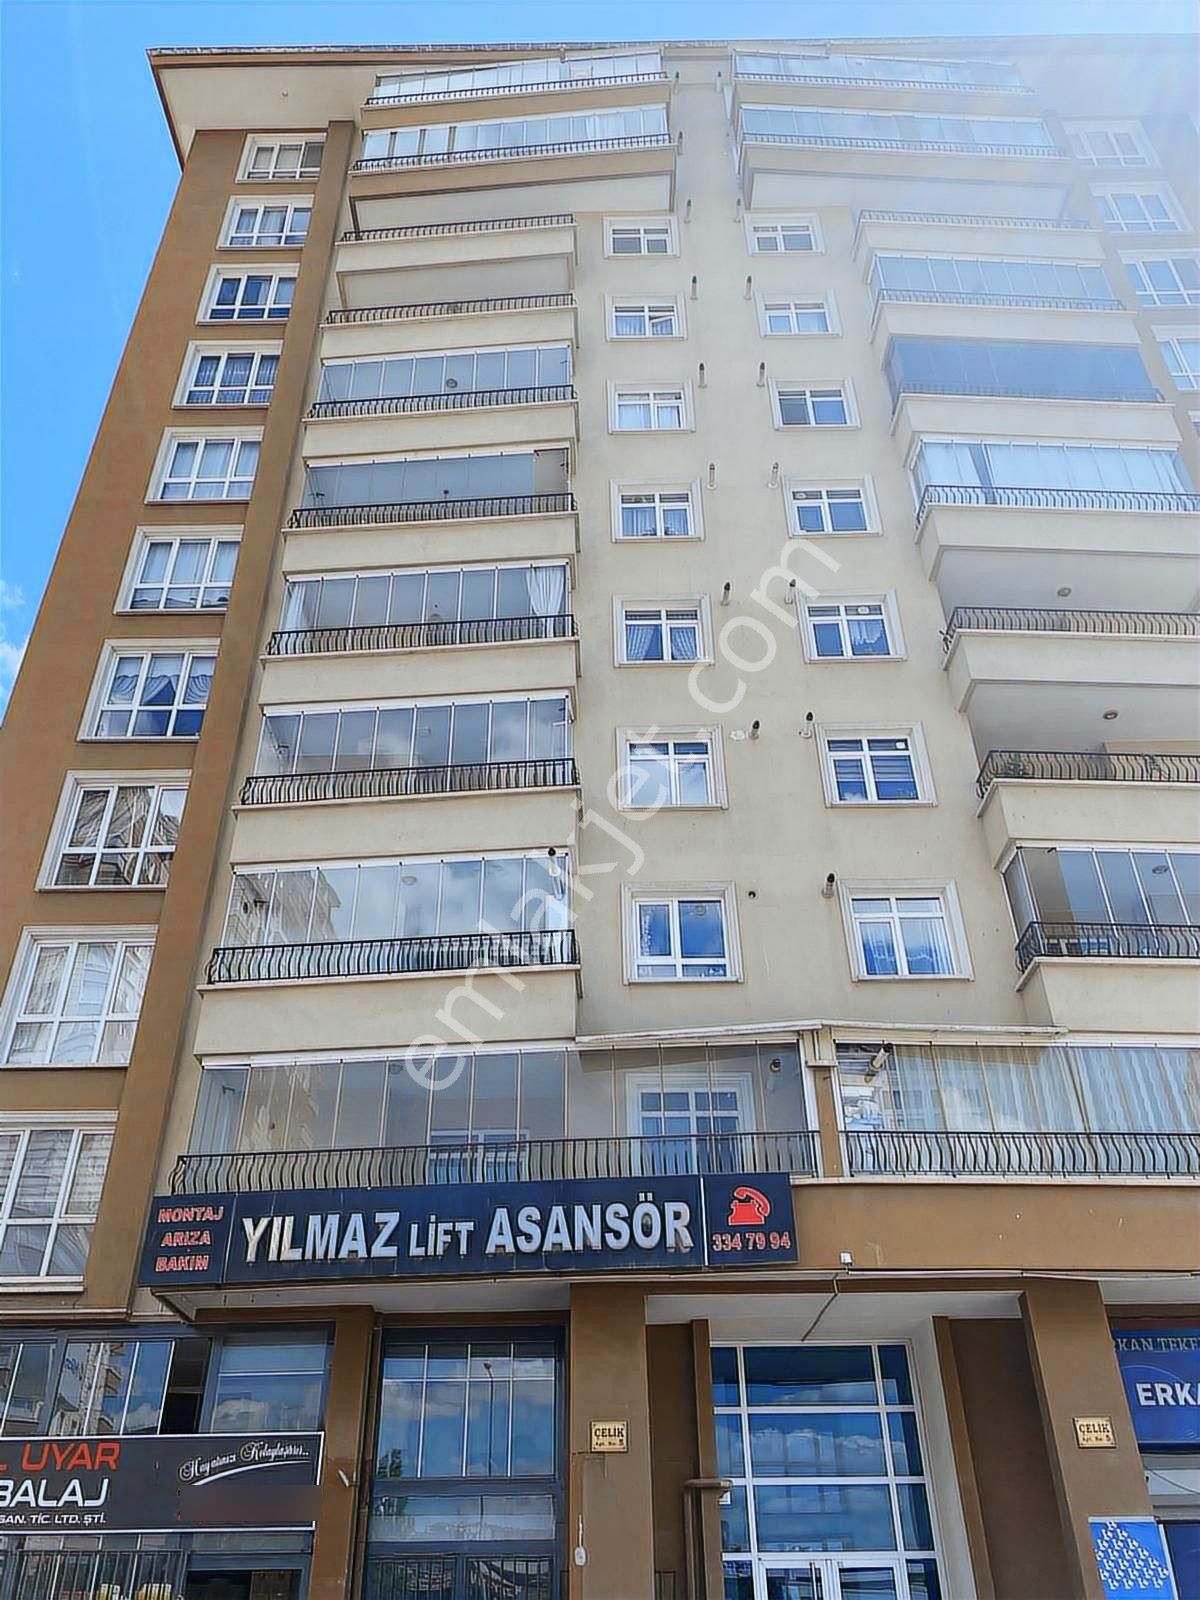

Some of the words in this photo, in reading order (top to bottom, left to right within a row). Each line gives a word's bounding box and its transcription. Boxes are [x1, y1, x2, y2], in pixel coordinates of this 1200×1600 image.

[157, 1206, 224, 1223] MONTAJ
[242, 1212, 400, 1262] YILMAZ
[484, 1192, 695, 1255] ASANSÖR
[160, 1230, 211, 1247] ARIZA
[712, 1232, 743, 1252] 334
[745, 1232, 766, 1250] 79
[769, 1231, 791, 1250] 94
[1135, 1382, 1200, 1406] ERK
[22, 1442, 120, 1471] UYAR
